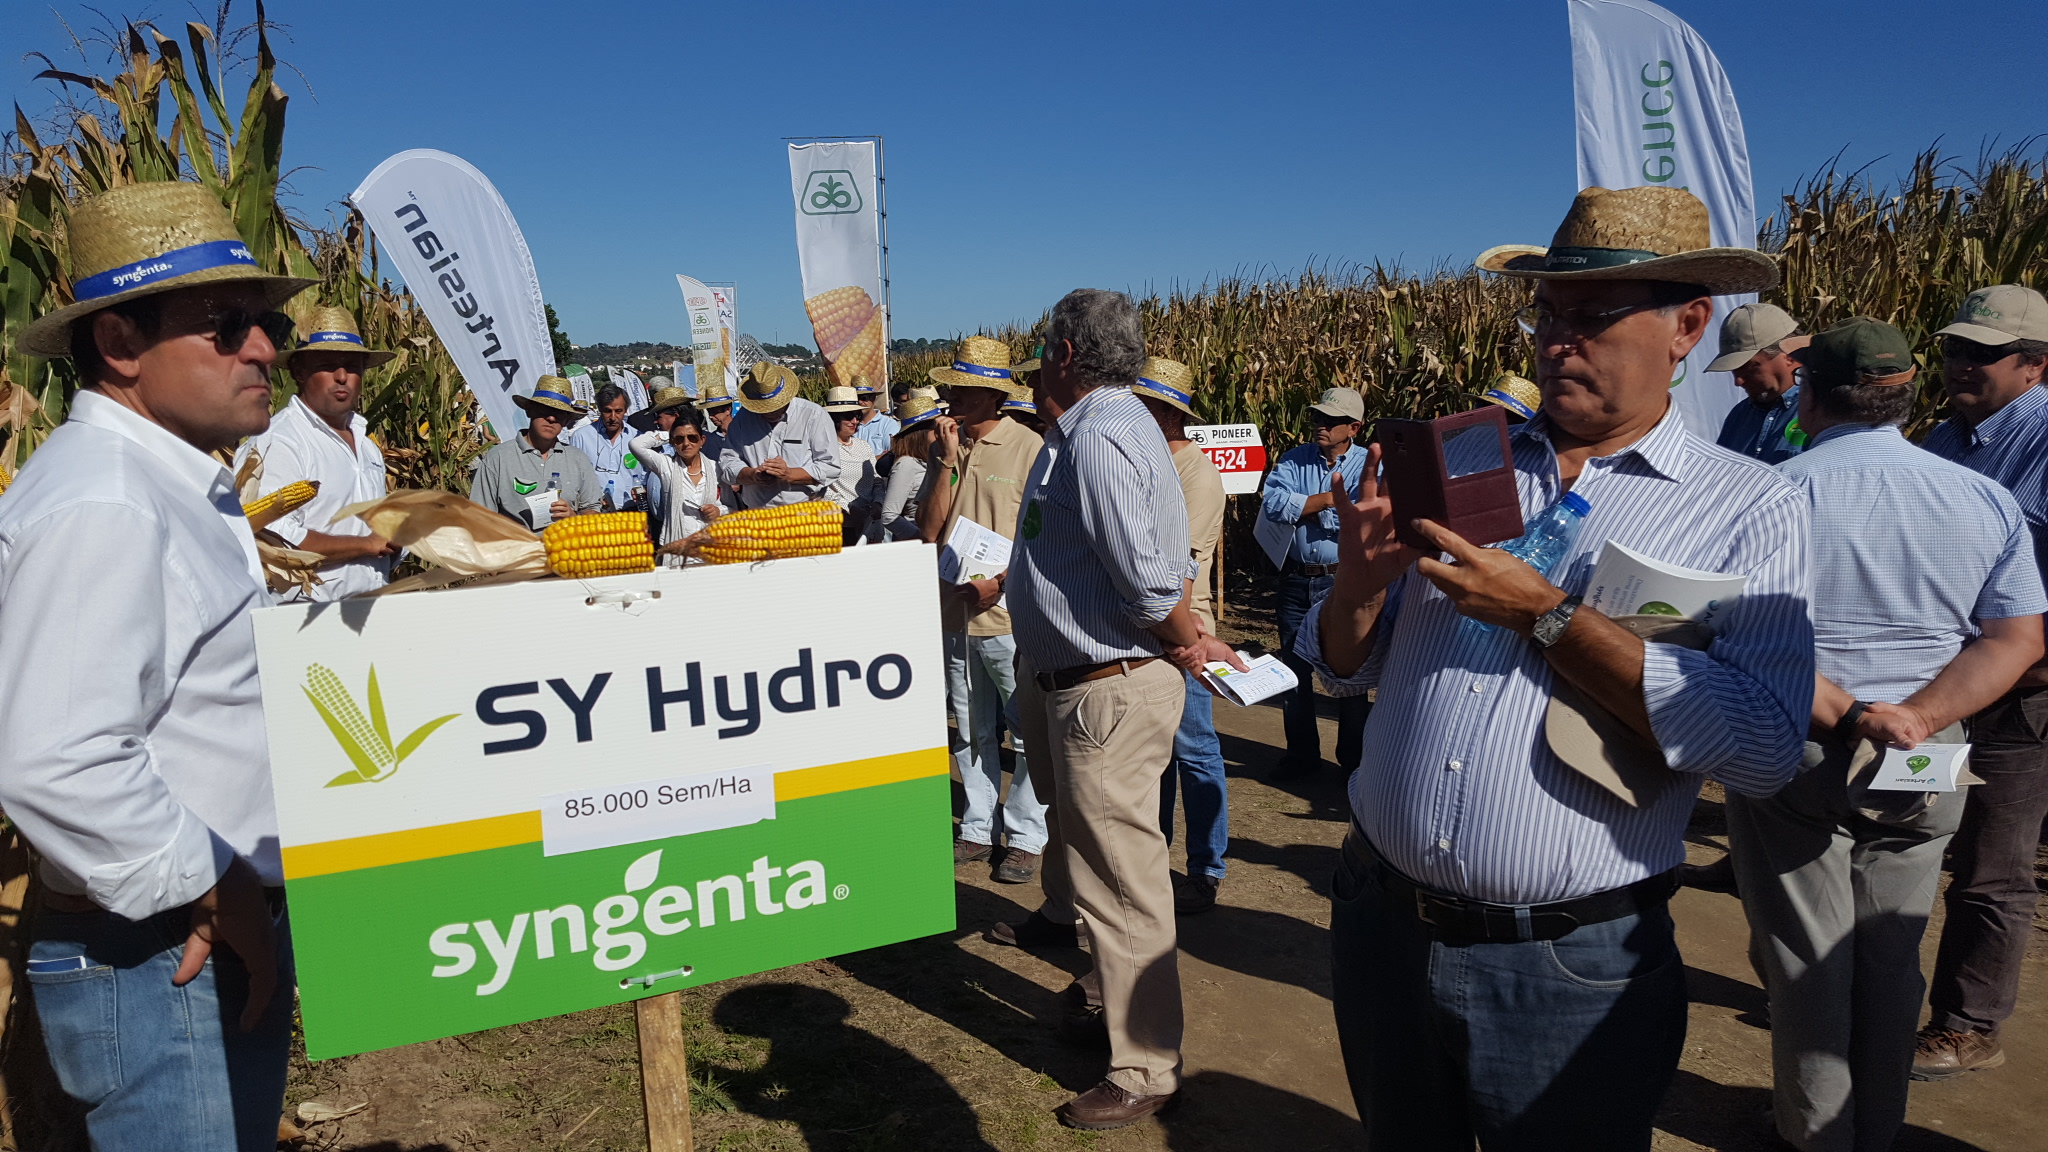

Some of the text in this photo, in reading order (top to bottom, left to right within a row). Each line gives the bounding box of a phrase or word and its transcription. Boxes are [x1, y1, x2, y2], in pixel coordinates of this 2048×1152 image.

[1211, 428, 1252, 439] PIONEER
[475, 647, 913, 756] SY Hydro
[564, 774, 753, 820] 85.000 Sem/Ha
